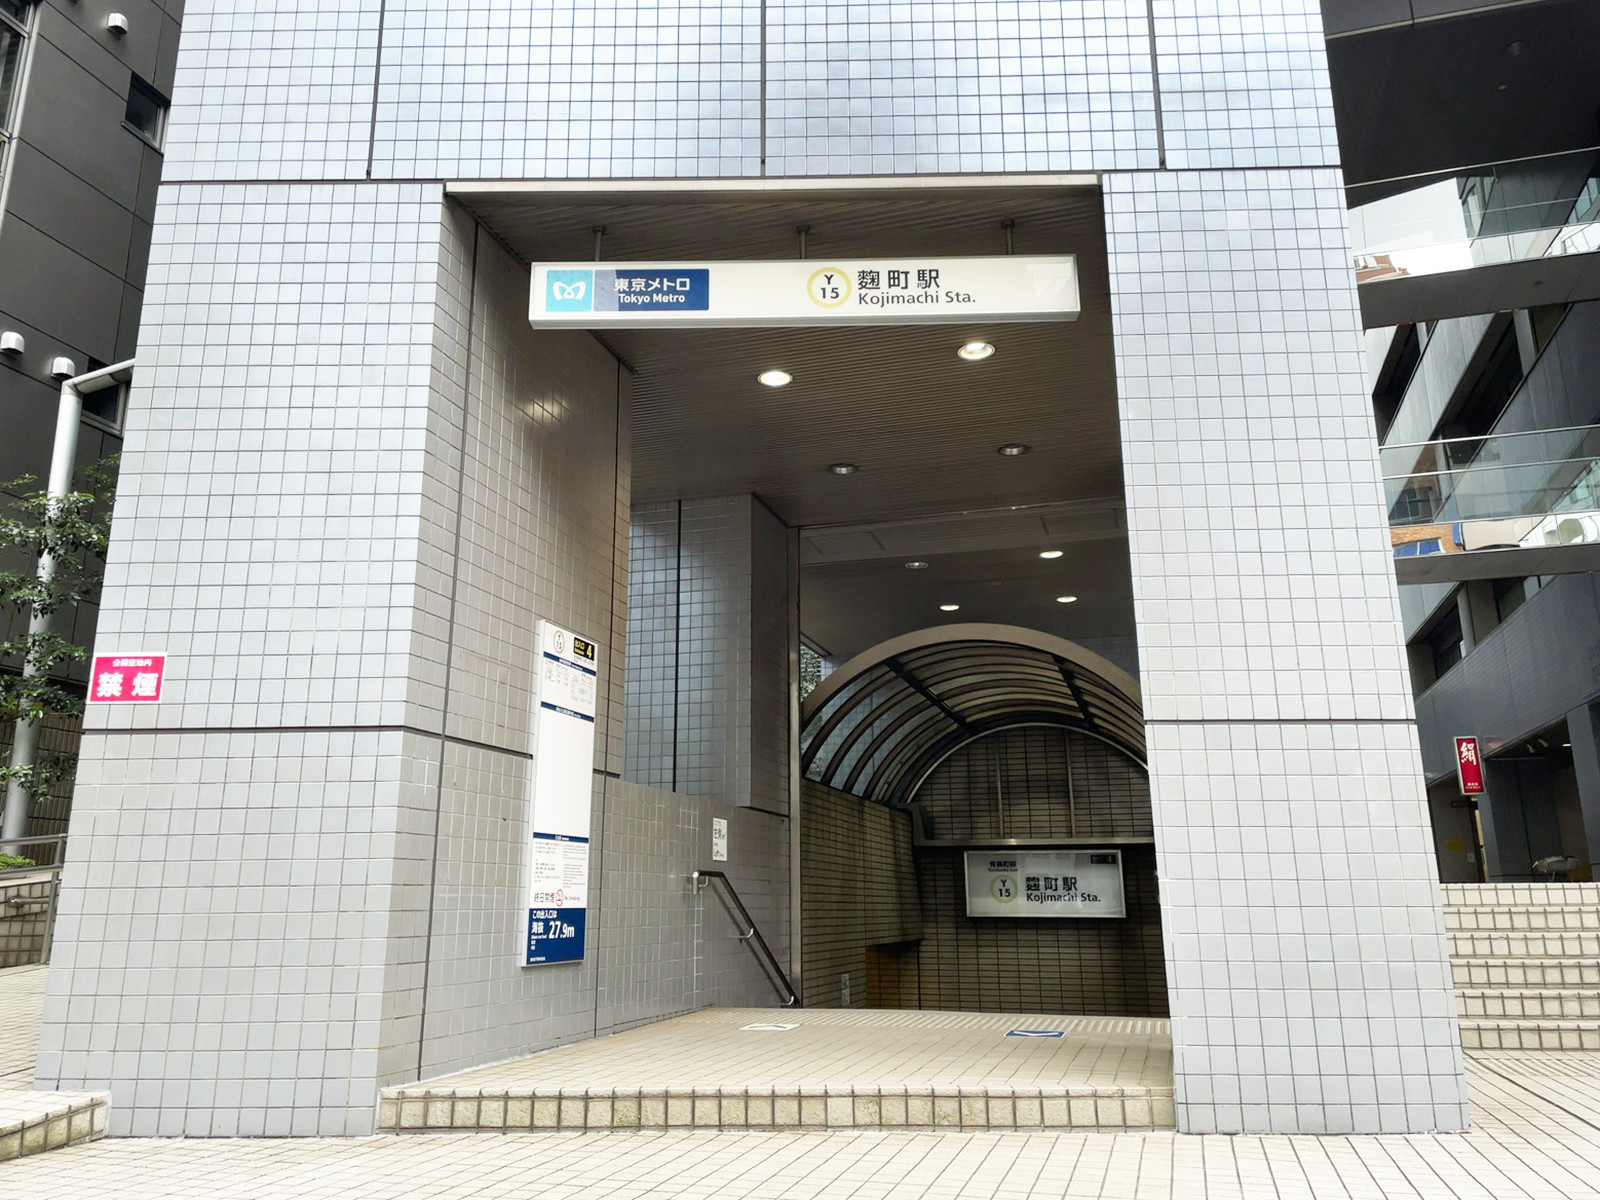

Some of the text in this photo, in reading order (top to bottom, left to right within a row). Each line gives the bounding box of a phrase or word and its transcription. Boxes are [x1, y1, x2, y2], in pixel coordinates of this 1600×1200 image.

[614, 277, 690, 292] 東京メトロ
[824, 274, 835, 285] Y
[618, 293, 686, 305] Tokyo Metro
[820, 287, 840, 299] 15
[858, 290, 976, 308] Kojimachi Sta.
[586, 644, 593, 659] 4
[96, 672, 159, 698] 禁煙
[1000, 879, 1008, 887] Y
[998, 888, 1011, 898] 15
[1026, 892, 1102, 904] Kojimachi Sta.
[548, 920, 575, 939] 27.9m
